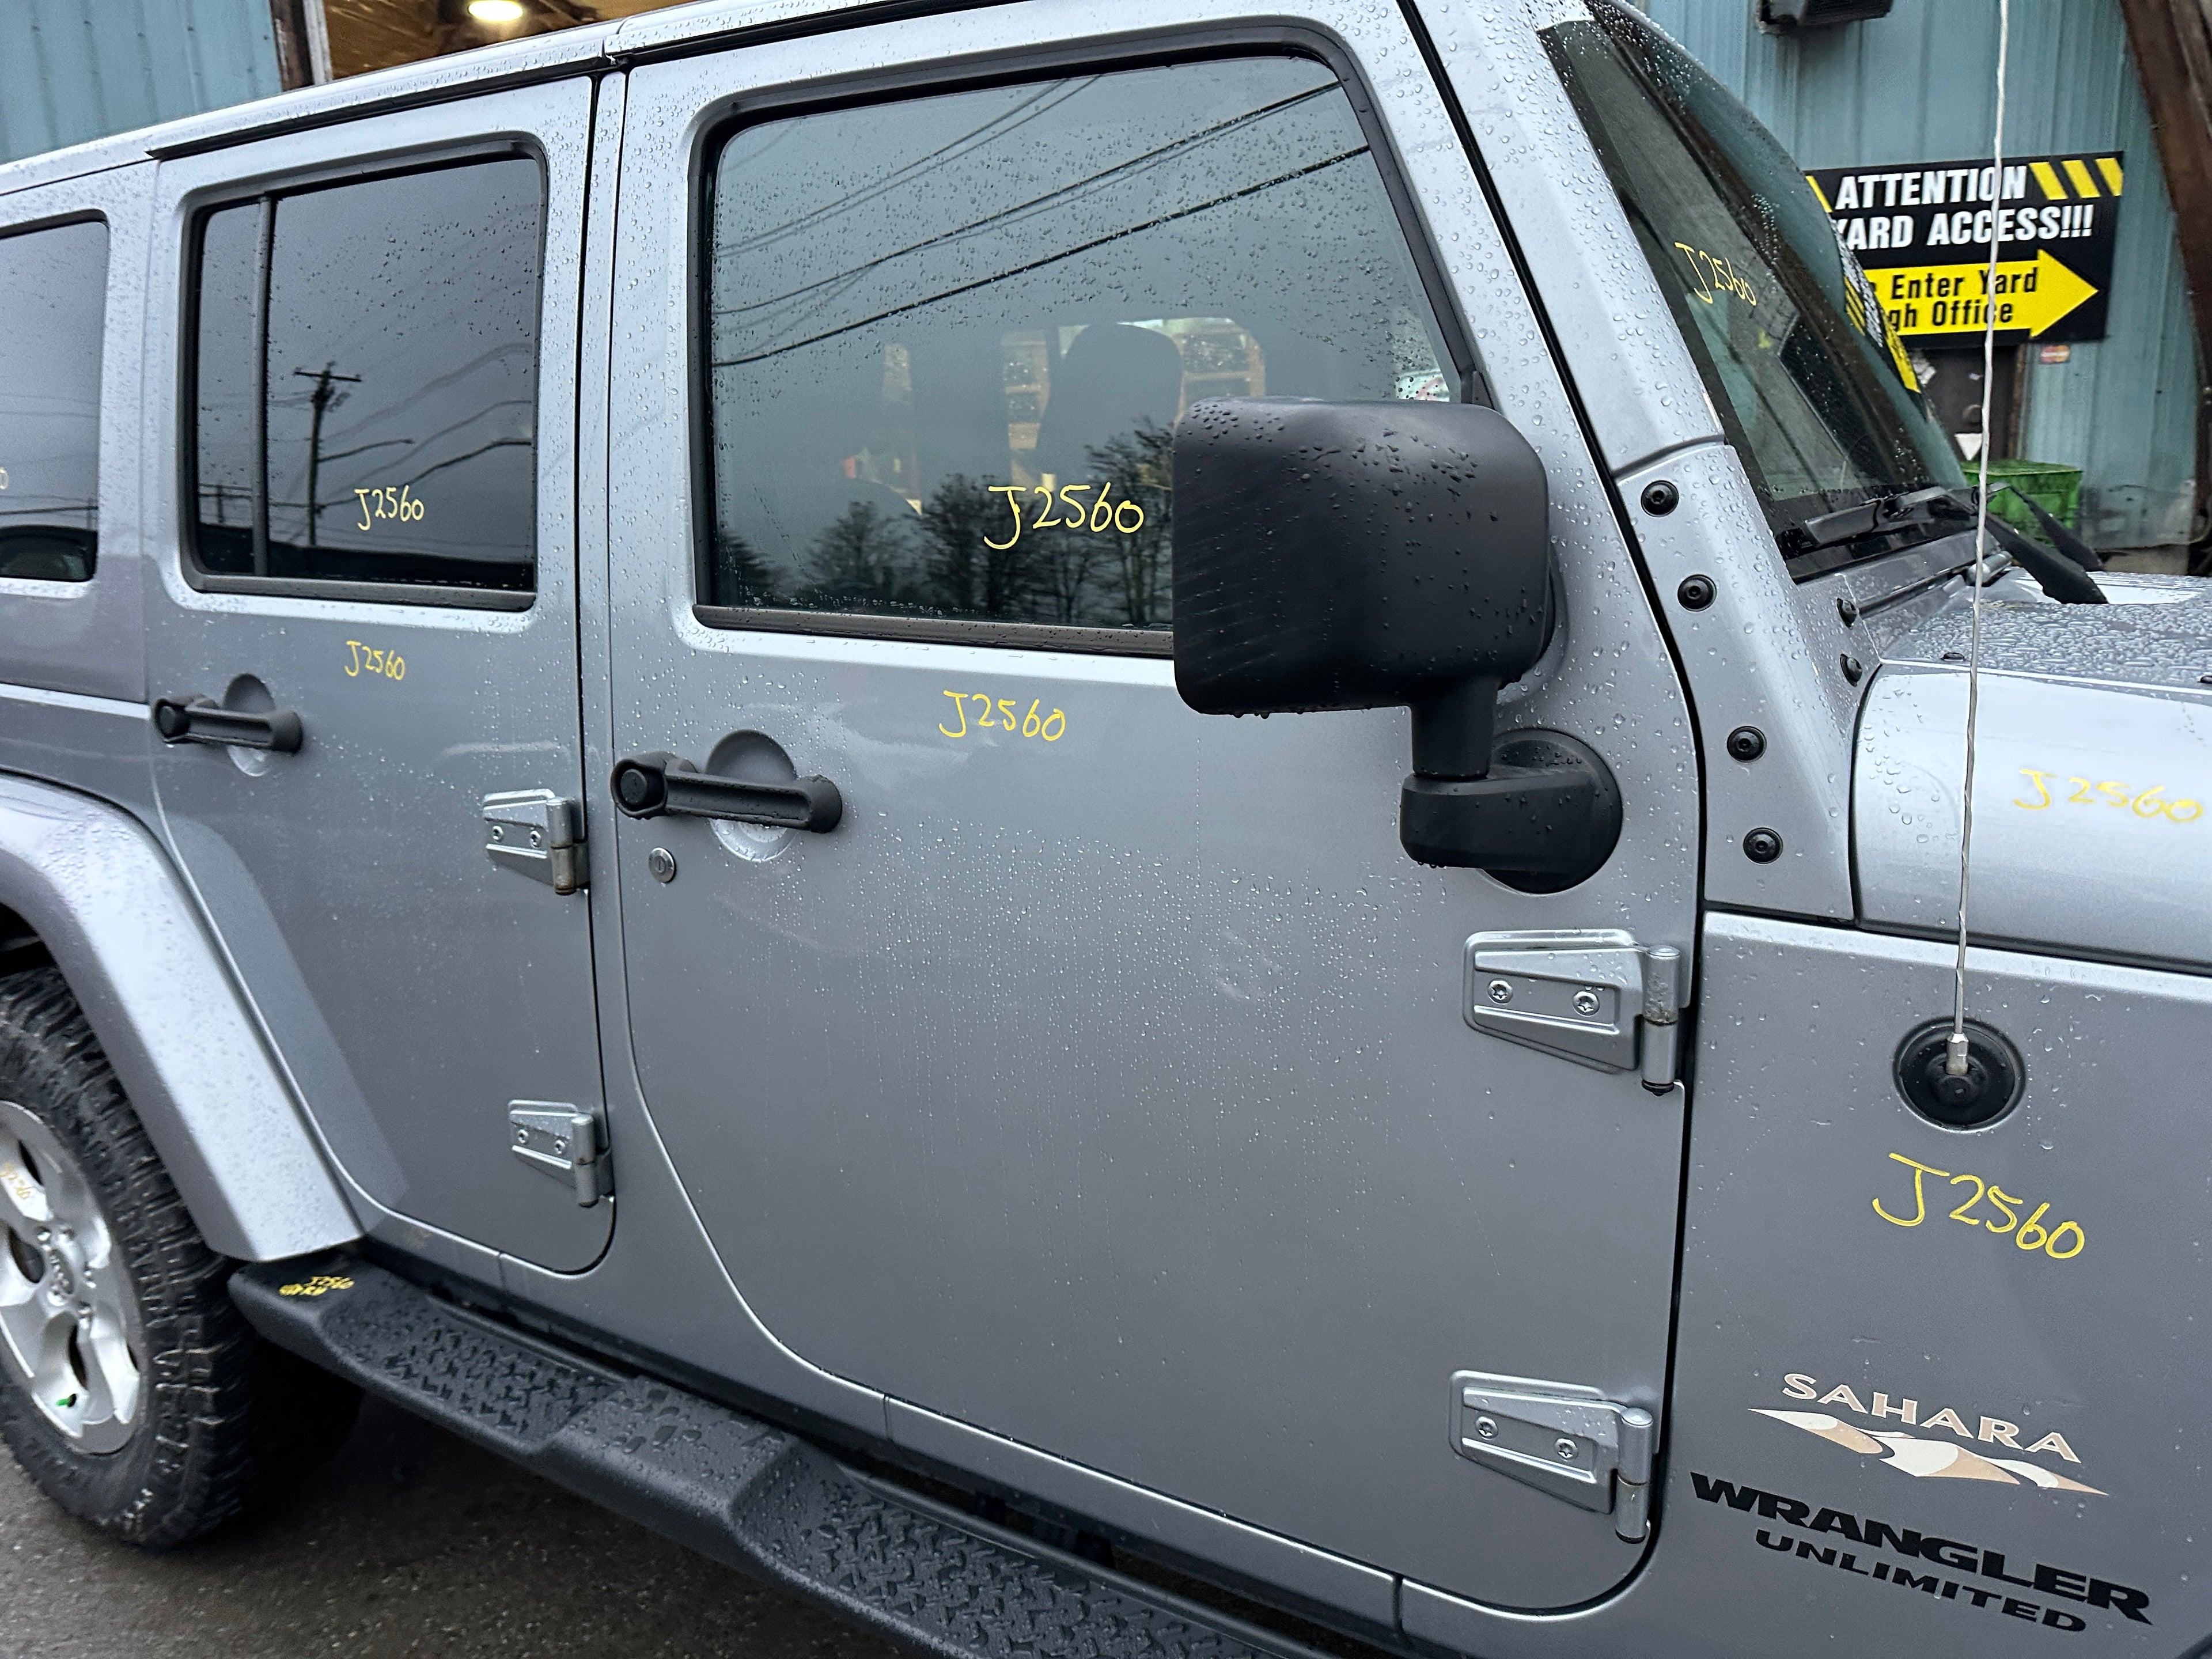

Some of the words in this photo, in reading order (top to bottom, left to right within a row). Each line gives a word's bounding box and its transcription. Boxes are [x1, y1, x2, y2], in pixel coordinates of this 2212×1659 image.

[1834, 165, 2027, 211] ATTENTION
[1926, 204, 2094, 247] ACCESS!!!
[1674, 242, 1756, 306] J2560
[1891, 272, 1964, 300] Enter
[1978, 267, 2039, 295] Yard
[354, 484, 425, 531] J2560
[983, 482, 1144, 550] J2560
[344, 639, 406, 681] J2560
[938, 690, 1066, 741] J2560
[2012, 768, 2204, 822] J2560
[1872, 1152, 2085, 1259] J2560
[1781, 1372, 2082, 1464] SAHARA
[1690, 1471, 2153, 1626] WRANGLER
[1755, 1528, 2087, 1632] UNLIMITED
